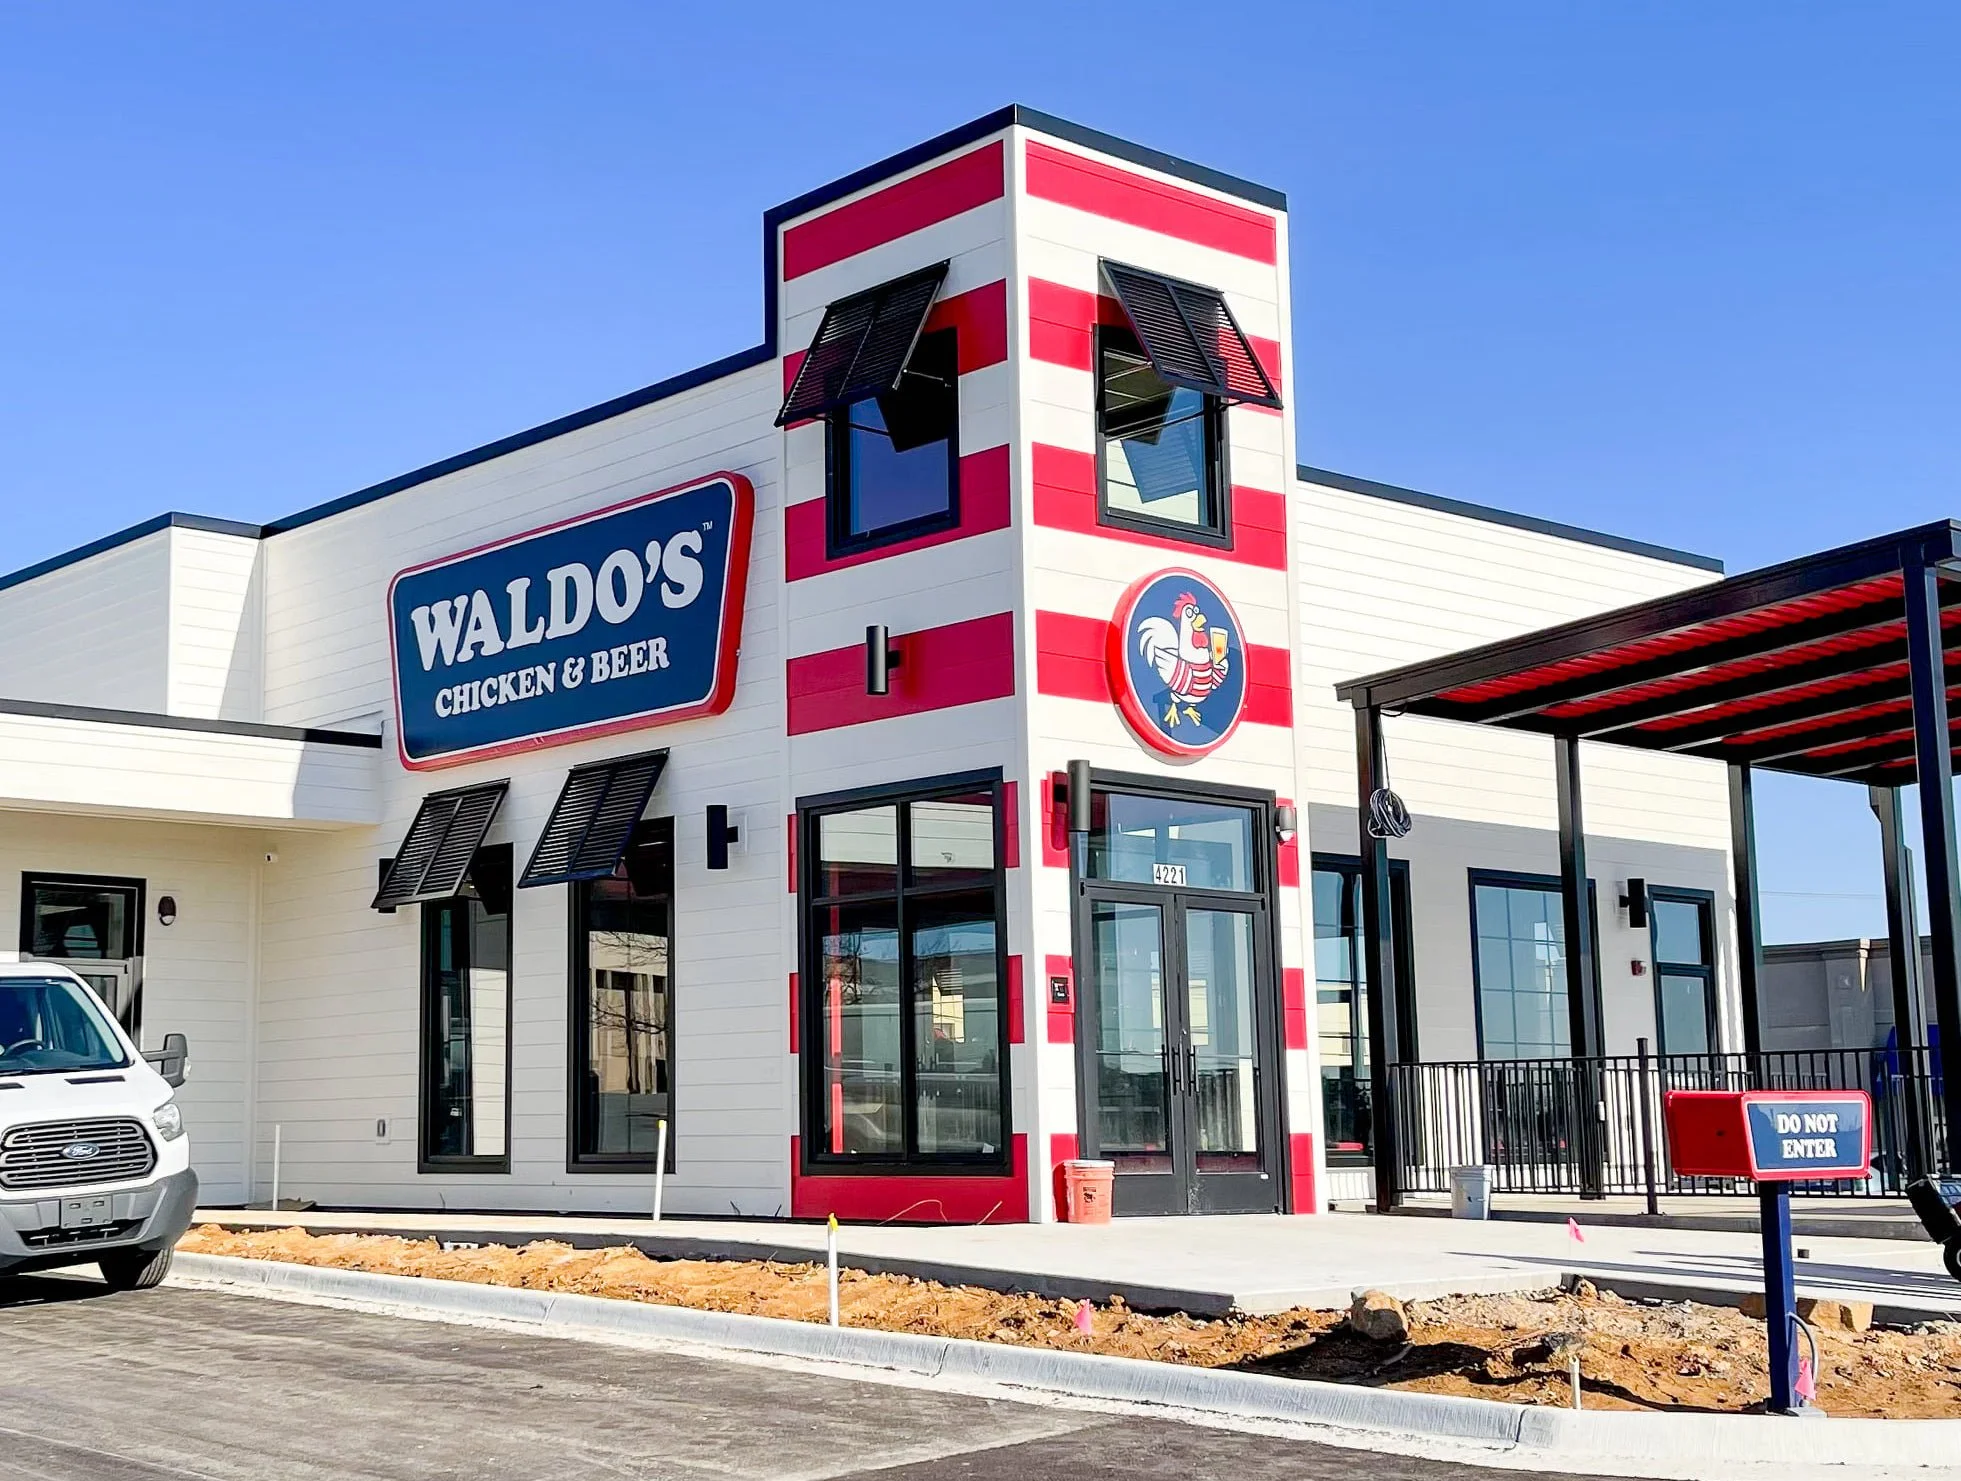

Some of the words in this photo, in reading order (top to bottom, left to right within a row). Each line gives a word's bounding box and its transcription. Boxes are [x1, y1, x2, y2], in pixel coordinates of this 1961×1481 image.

[410, 529, 704, 672] WALDO'S
[434, 661, 557, 718] CHICKEN
[561, 657, 586, 689] &
[590, 636, 670, 684] BEER
[1155, 865, 1184, 884] 4221
[1777, 1114, 1801, 1133] DO
[1804, 1113, 1838, 1133] NOT
[1782, 1139, 1837, 1159] ENTER
